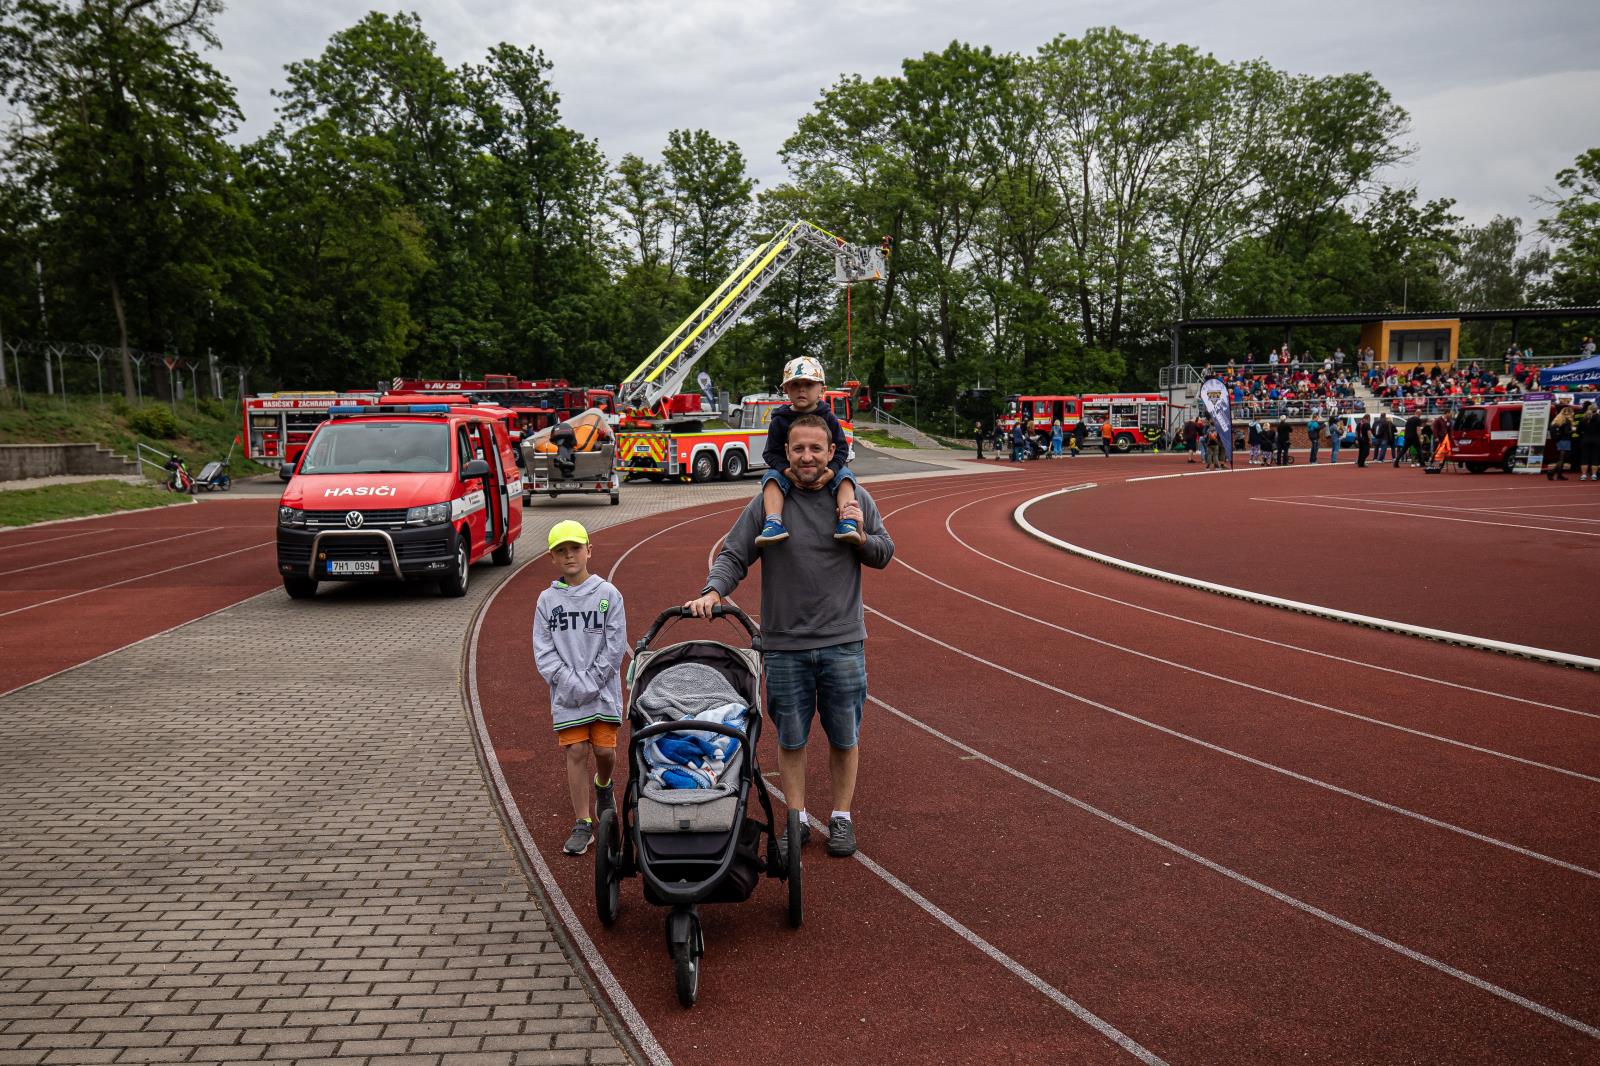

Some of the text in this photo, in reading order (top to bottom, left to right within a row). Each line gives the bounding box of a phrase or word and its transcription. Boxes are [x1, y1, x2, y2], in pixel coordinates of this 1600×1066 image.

[431, 382, 446, 390] AV
[324, 485, 397, 497] HASIČI
[333, 562, 375, 571] 7H1 0994
